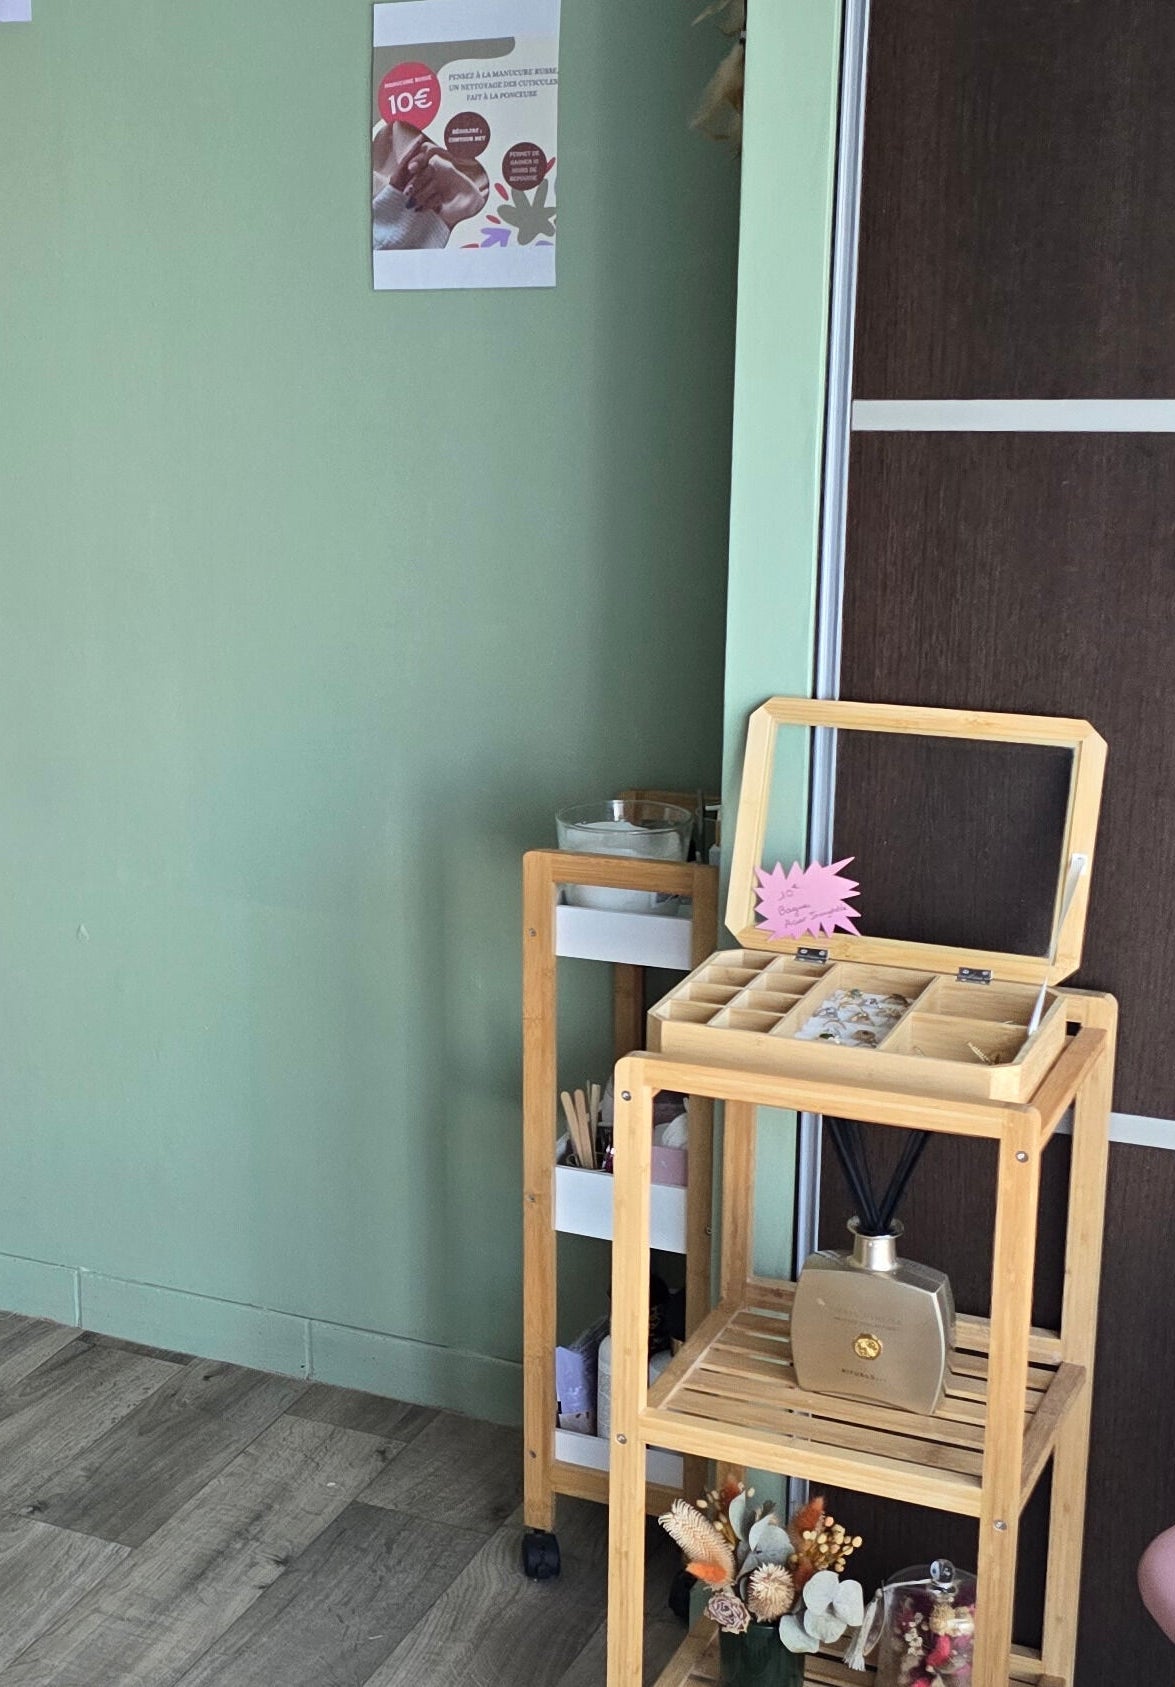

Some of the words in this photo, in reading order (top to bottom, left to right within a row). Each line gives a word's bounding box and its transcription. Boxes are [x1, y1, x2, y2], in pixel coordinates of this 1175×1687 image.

[492, 68, 533, 78] MANUCURE
[449, 84, 460, 92] UN
[461, 81, 503, 91] NETTOYAGE
[388, 87, 433, 115] 10€
[467, 93, 483, 101] FAIT
